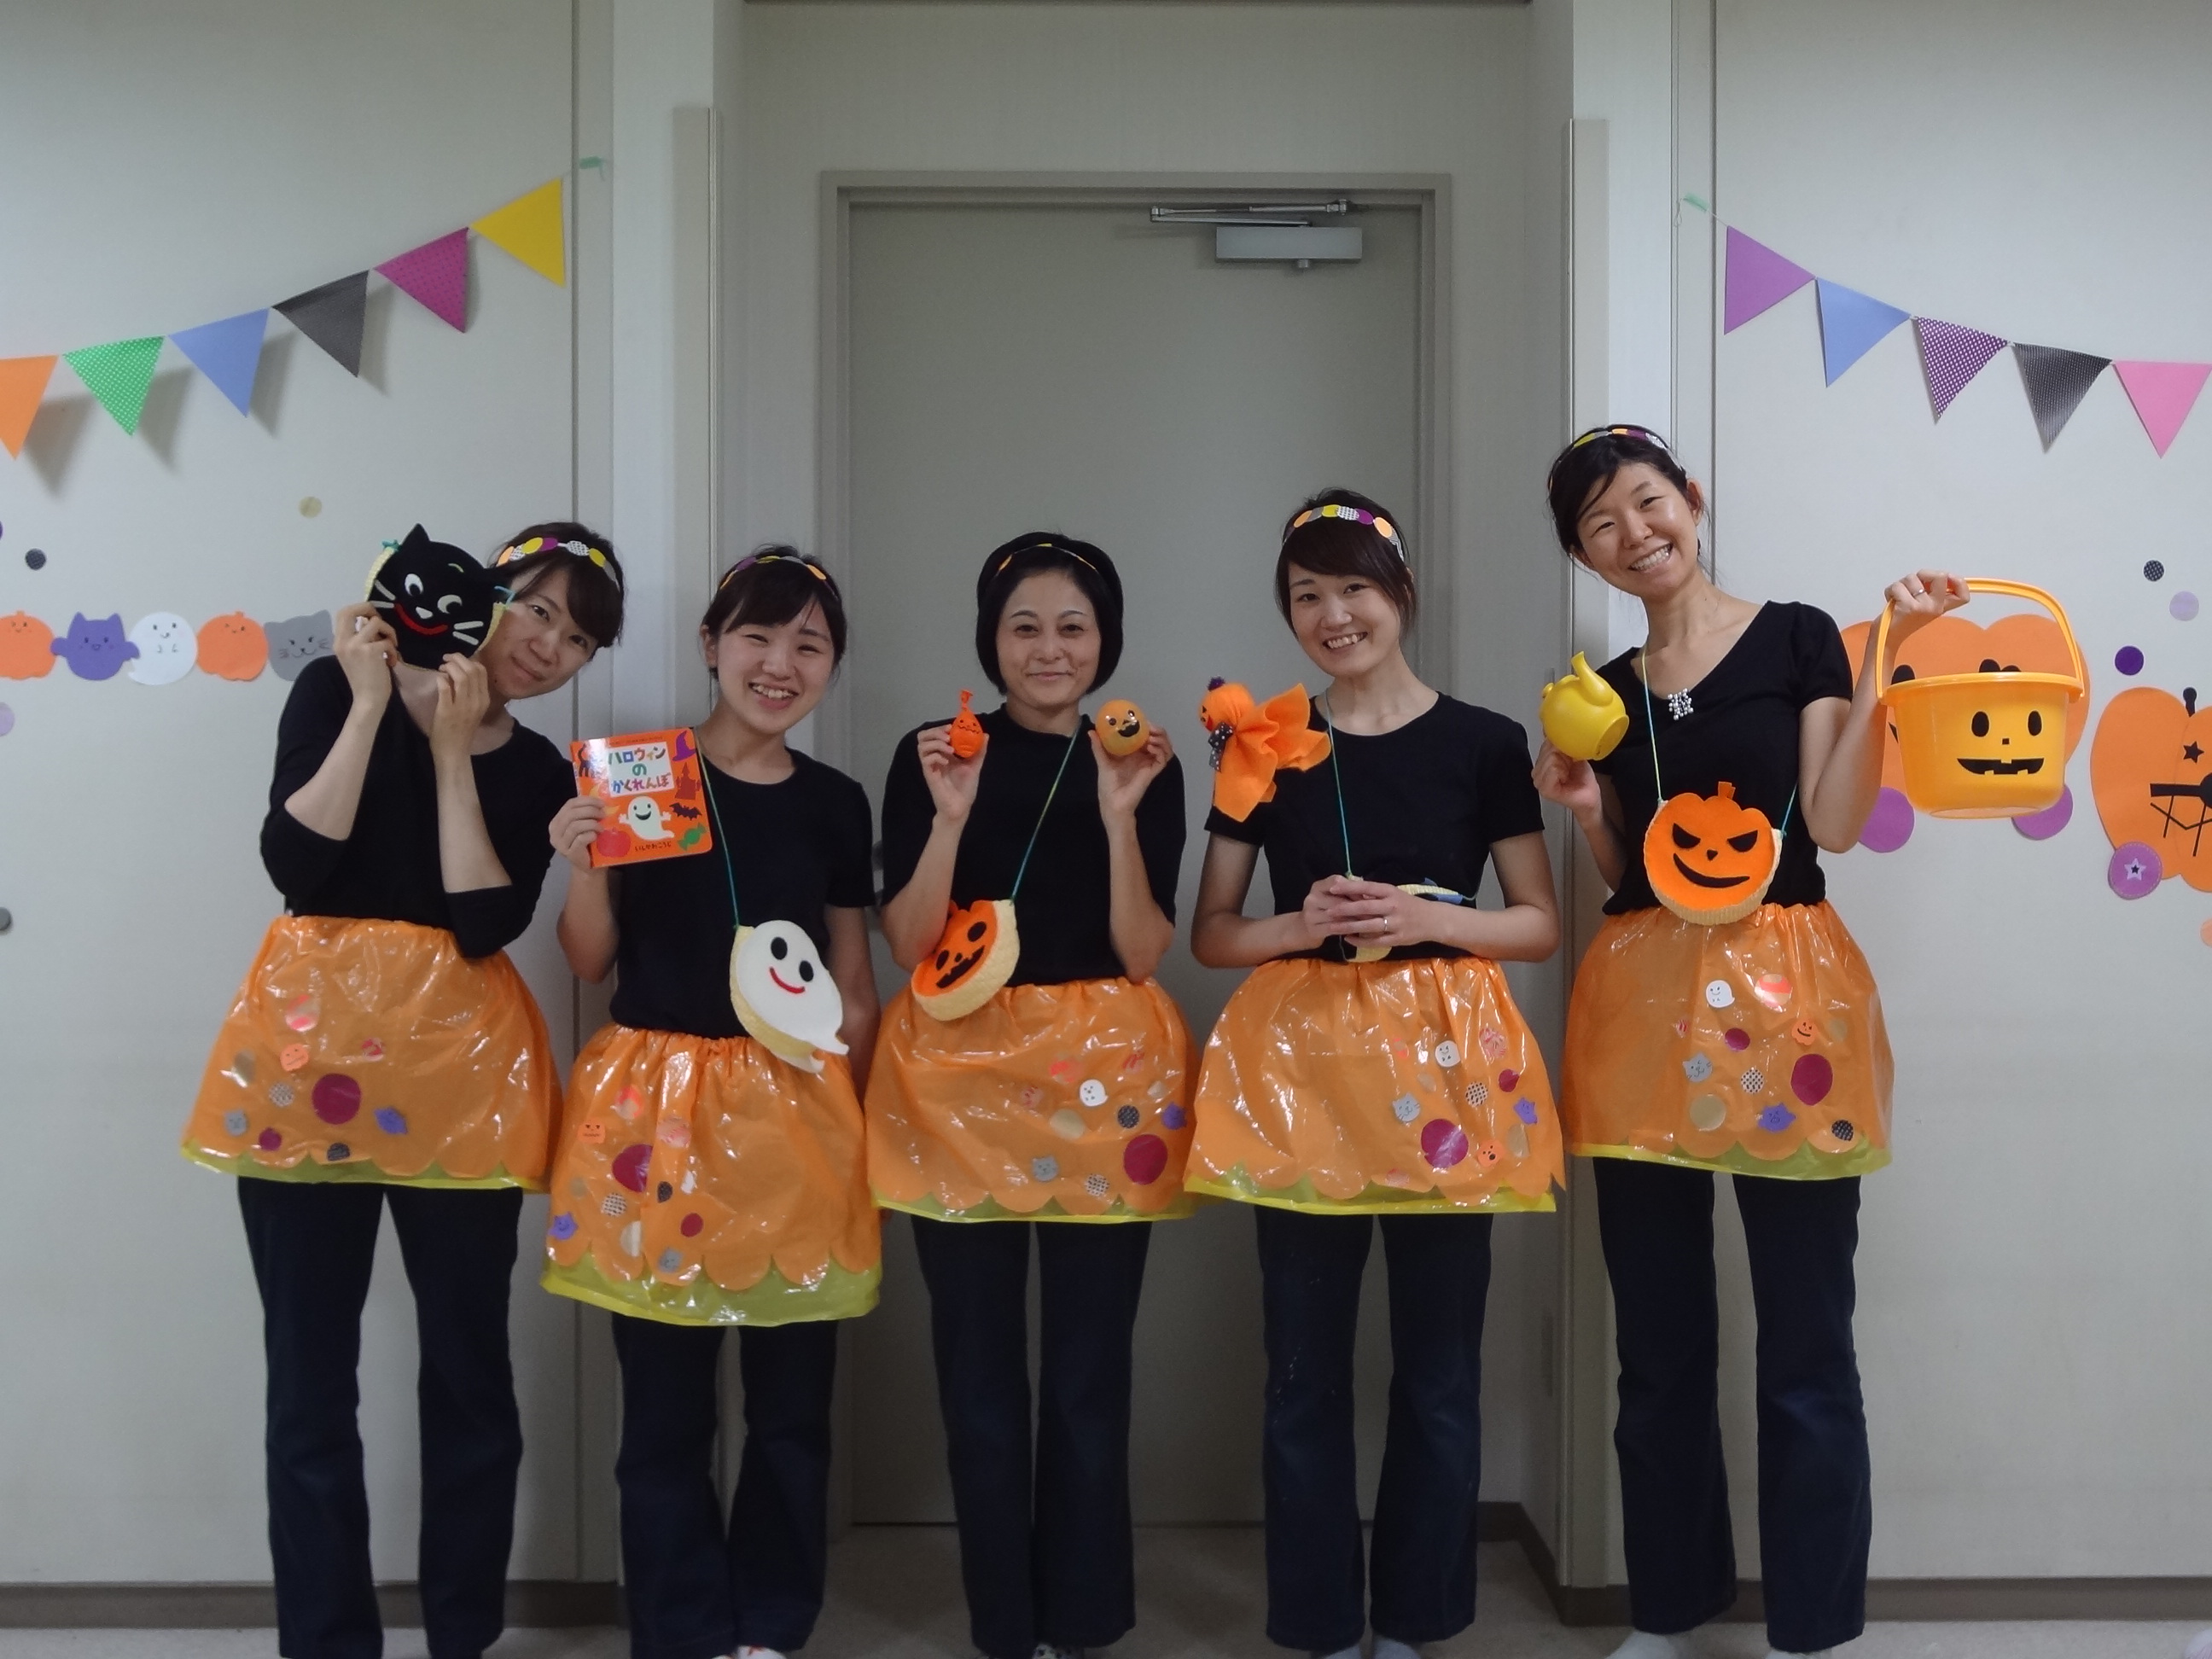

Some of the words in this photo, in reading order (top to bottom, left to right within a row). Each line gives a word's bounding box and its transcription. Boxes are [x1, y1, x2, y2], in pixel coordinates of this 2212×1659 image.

[608, 747, 666, 765] ハロウィン
[632, 763, 647, 777] の
[613, 772, 672, 794] かくれんぼ
